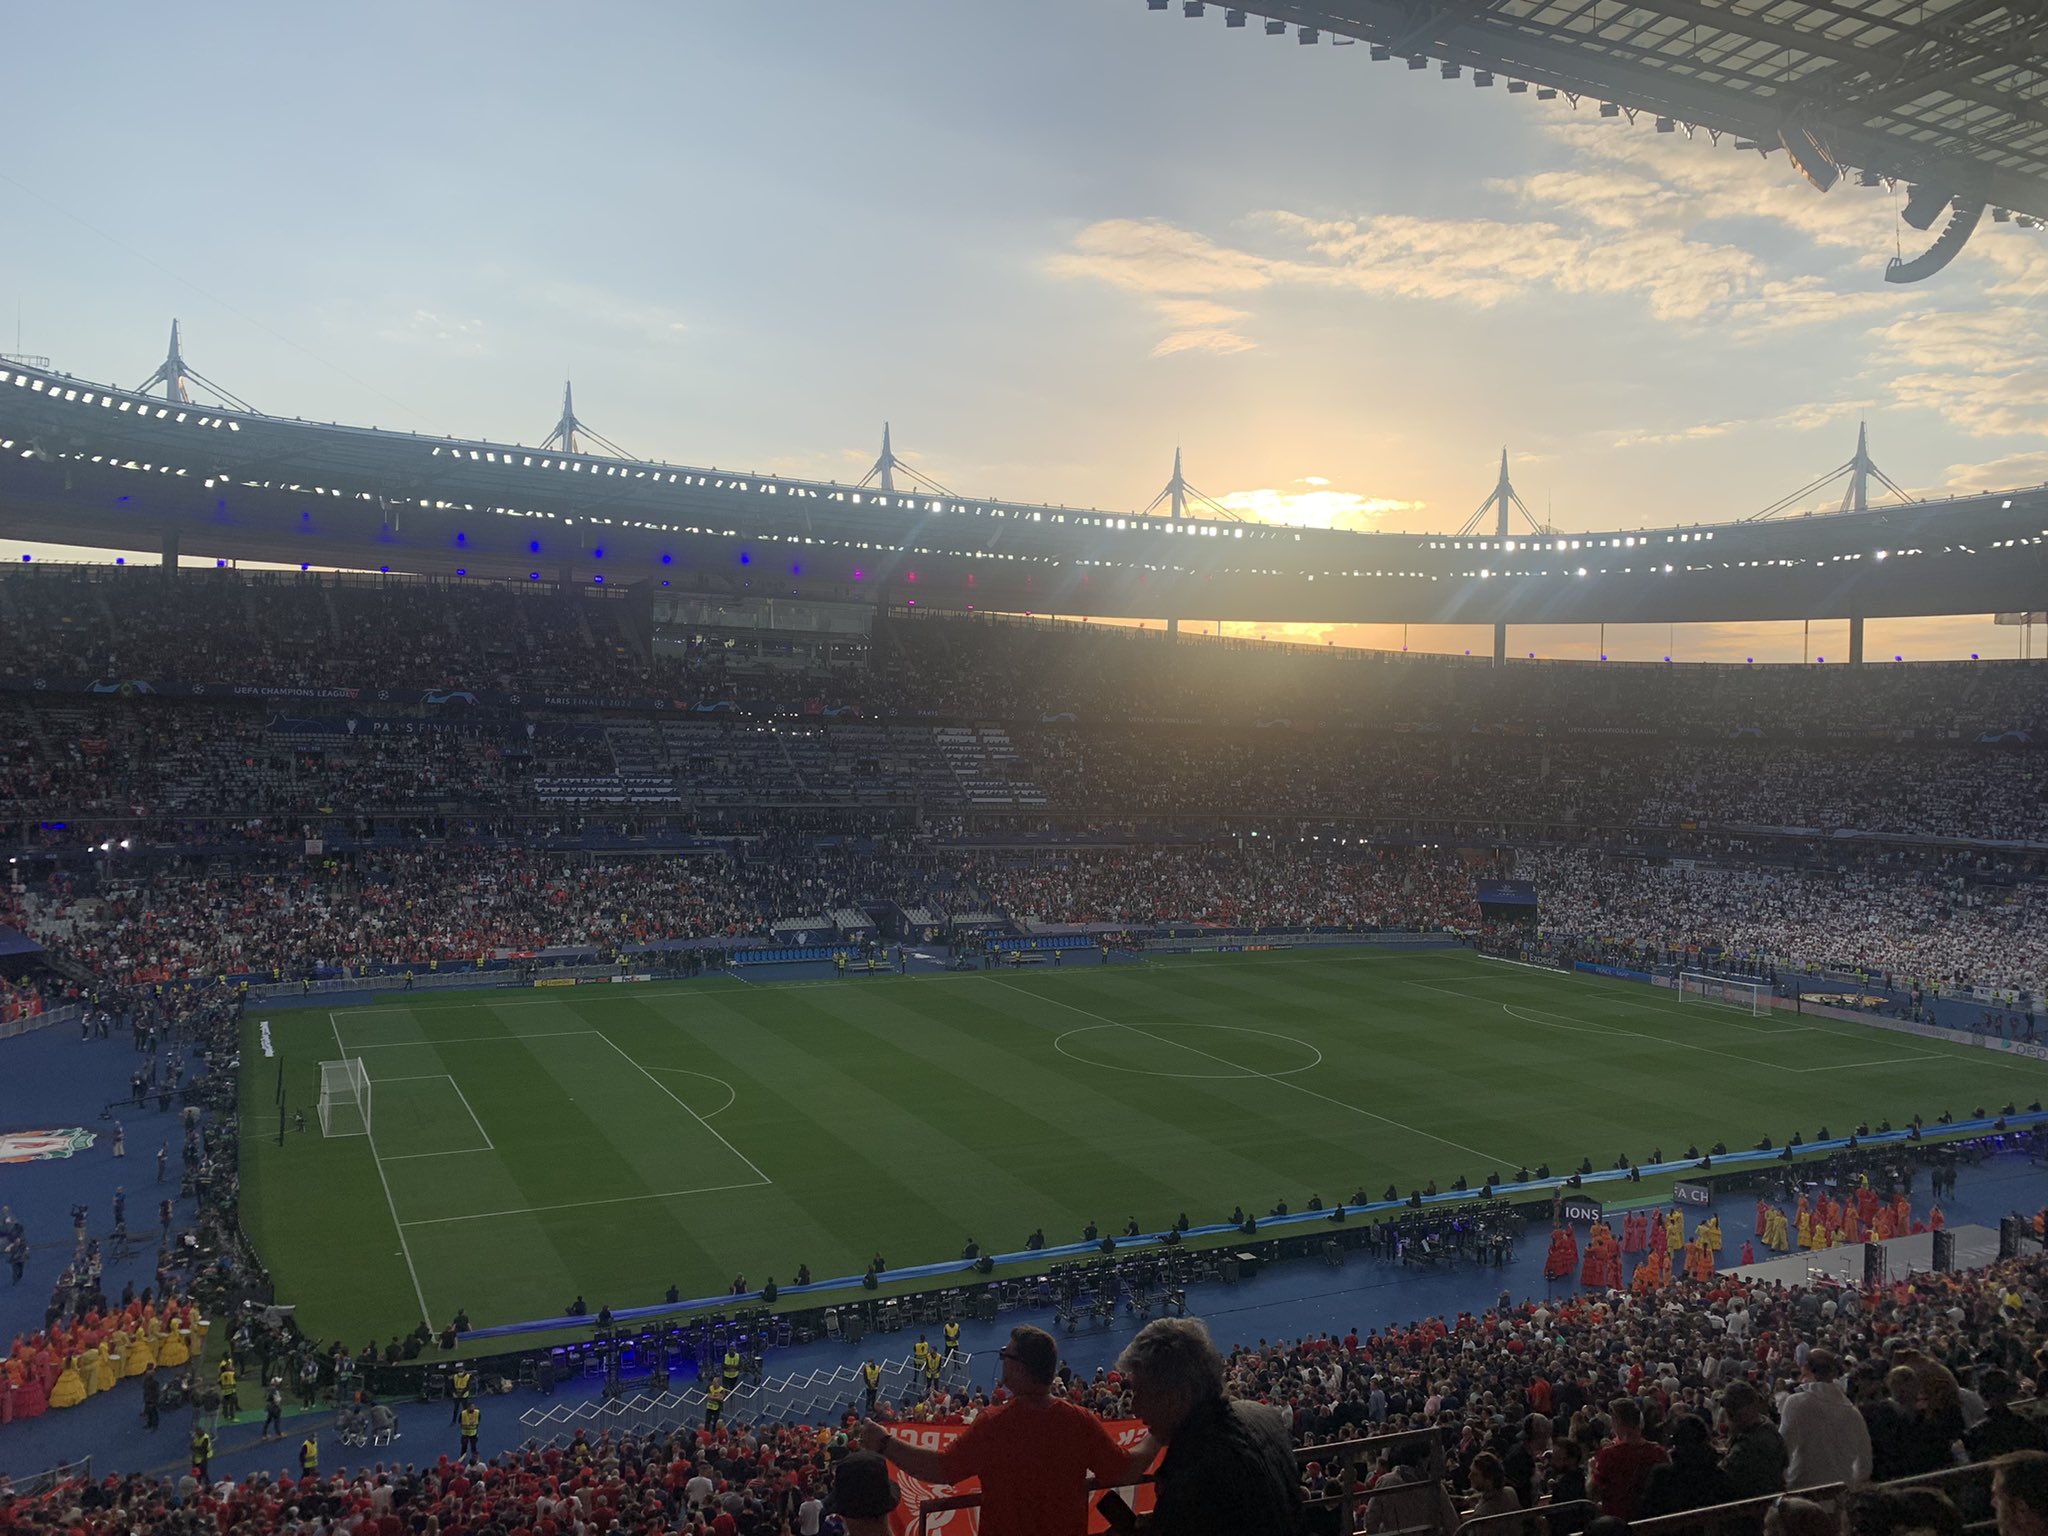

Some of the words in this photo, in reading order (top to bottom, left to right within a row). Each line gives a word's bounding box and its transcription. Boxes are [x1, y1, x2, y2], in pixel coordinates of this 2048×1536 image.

[233, 687, 258, 695] UEFA
[261, 687, 314, 697] CHAMPIONS
[545, 697, 570, 705] PARIS
[573, 698, 604, 706] FINALE
[373, 722, 412, 733] PAS
[1690, 1190, 1709, 1203] CH
[1565, 1206, 1599, 1221] IONS
